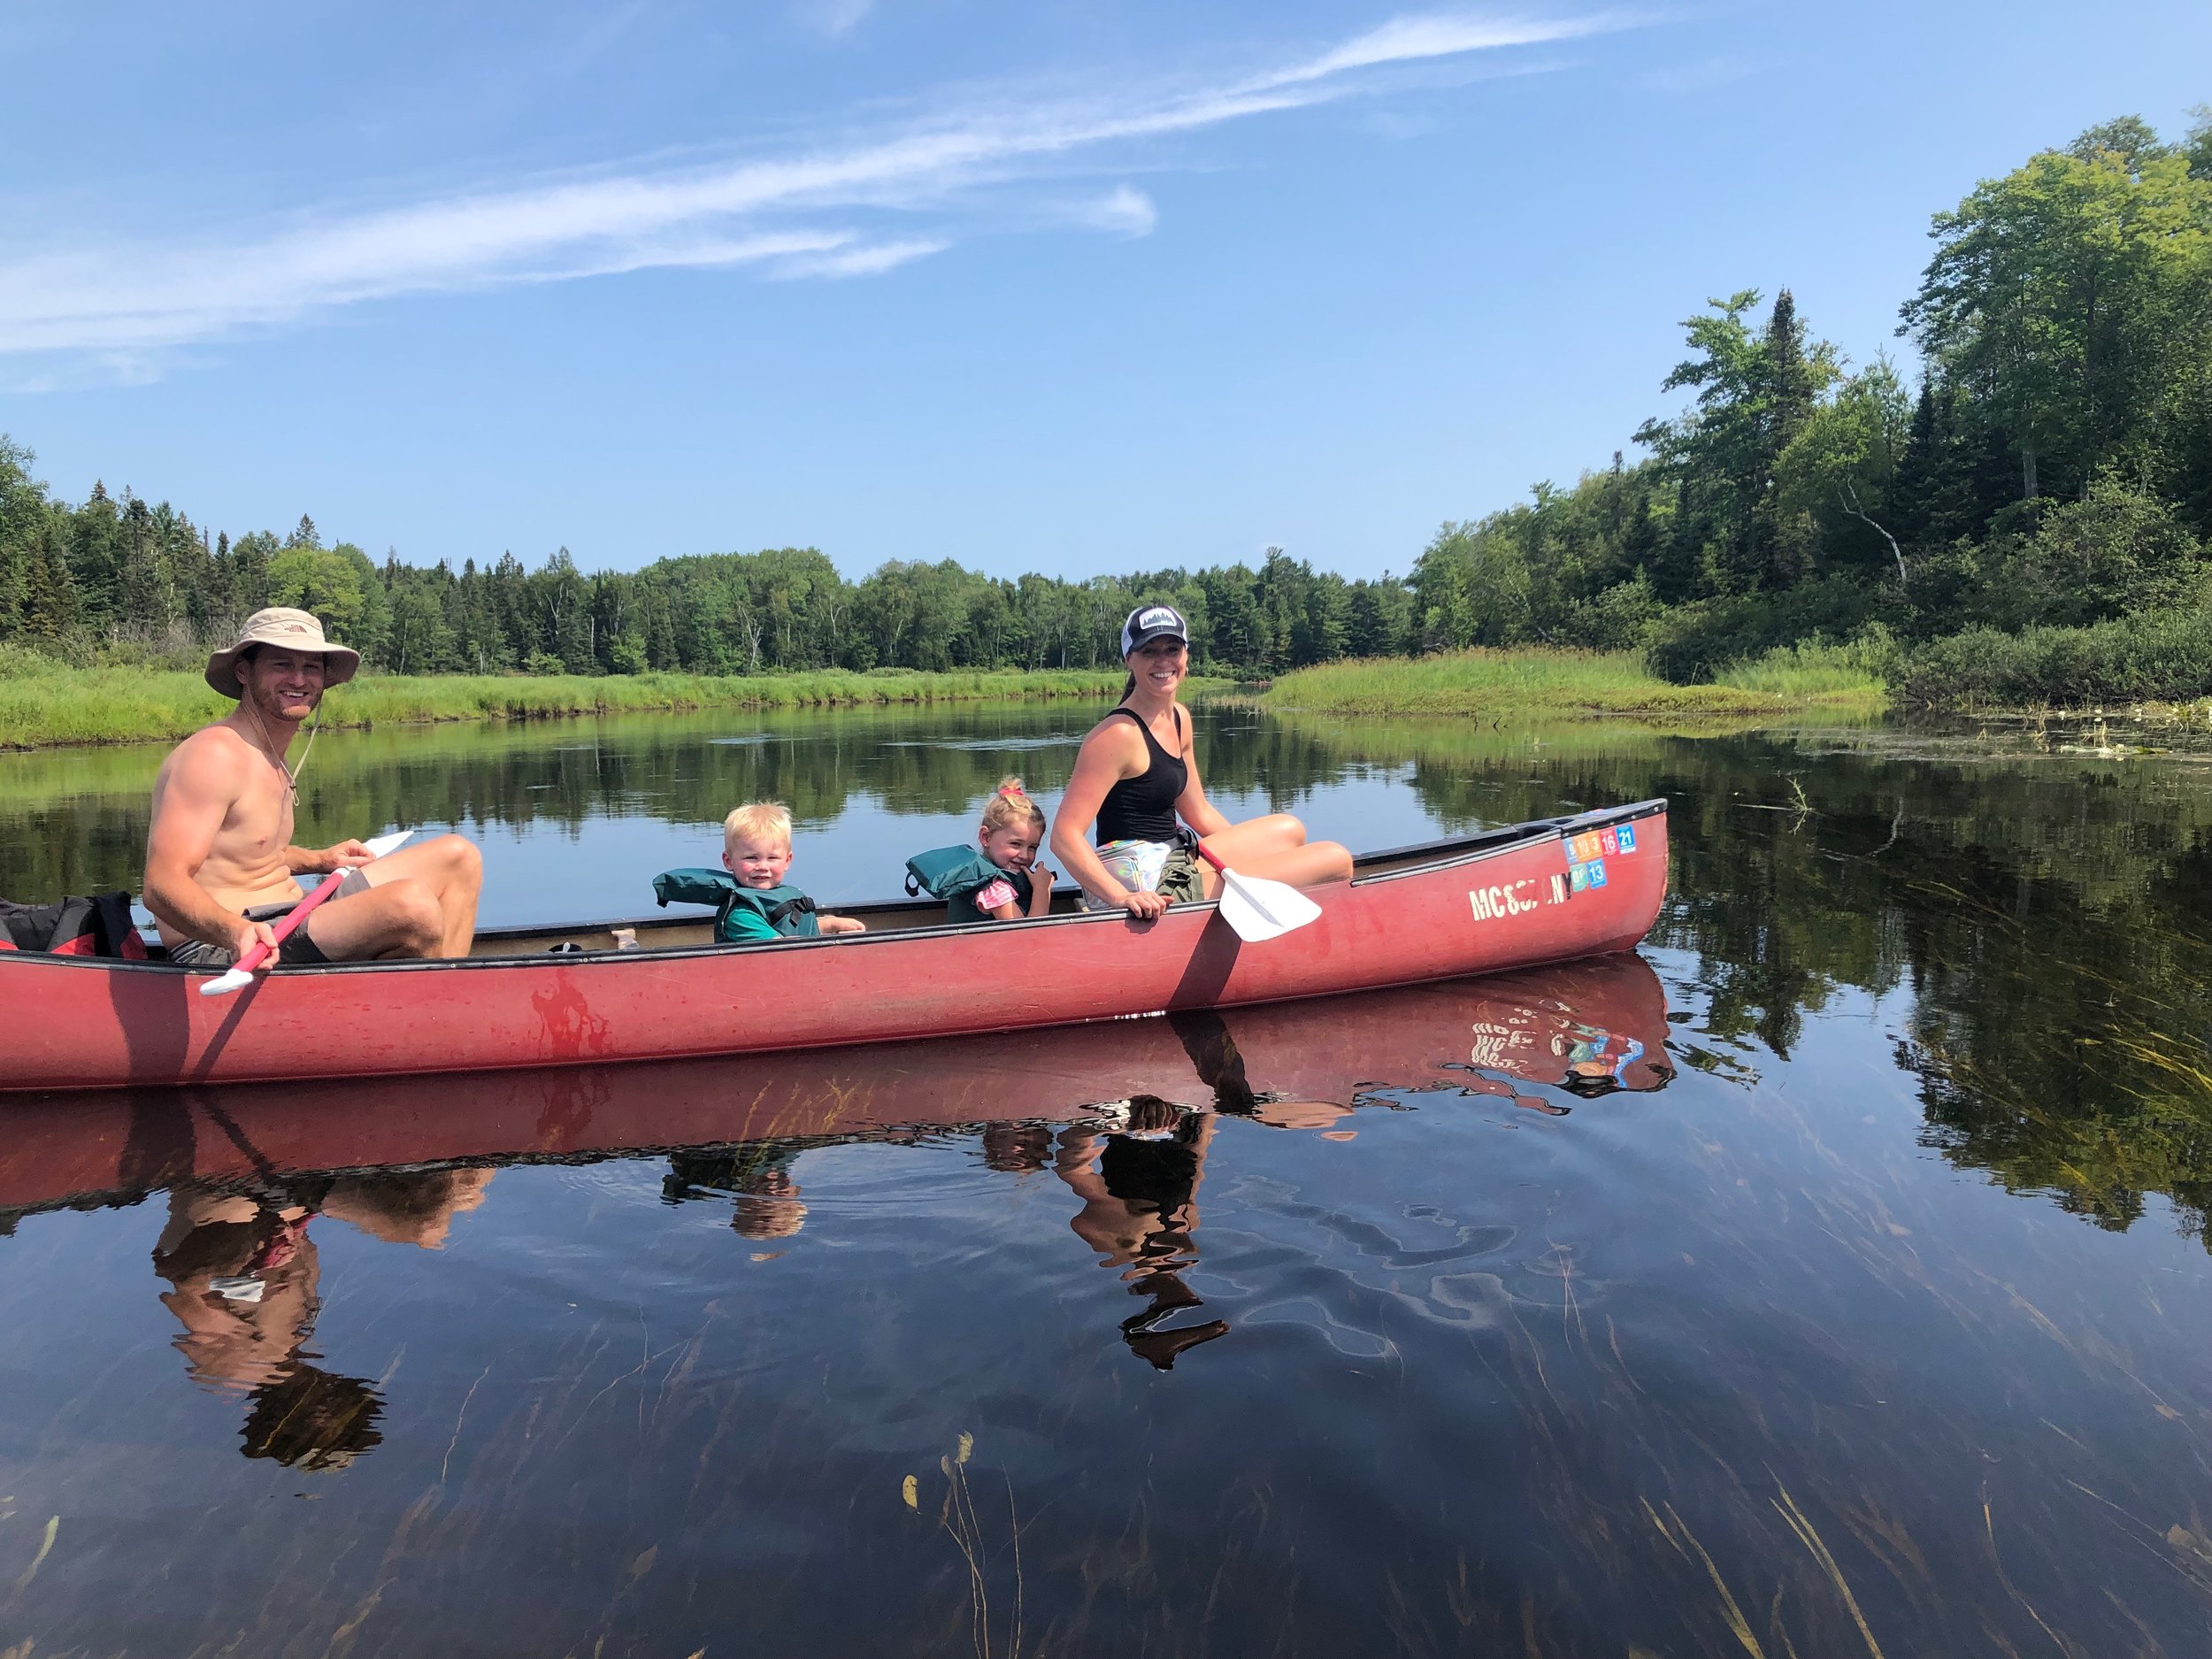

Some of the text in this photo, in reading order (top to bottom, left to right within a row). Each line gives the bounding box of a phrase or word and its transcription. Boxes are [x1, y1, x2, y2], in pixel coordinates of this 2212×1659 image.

[1591, 836, 1600, 850] 3
[1602, 834, 1616, 851] 16
[1619, 831, 1632, 846] 21
[1577, 840, 1589, 854] 10
[1590, 864, 1603, 881] 13
